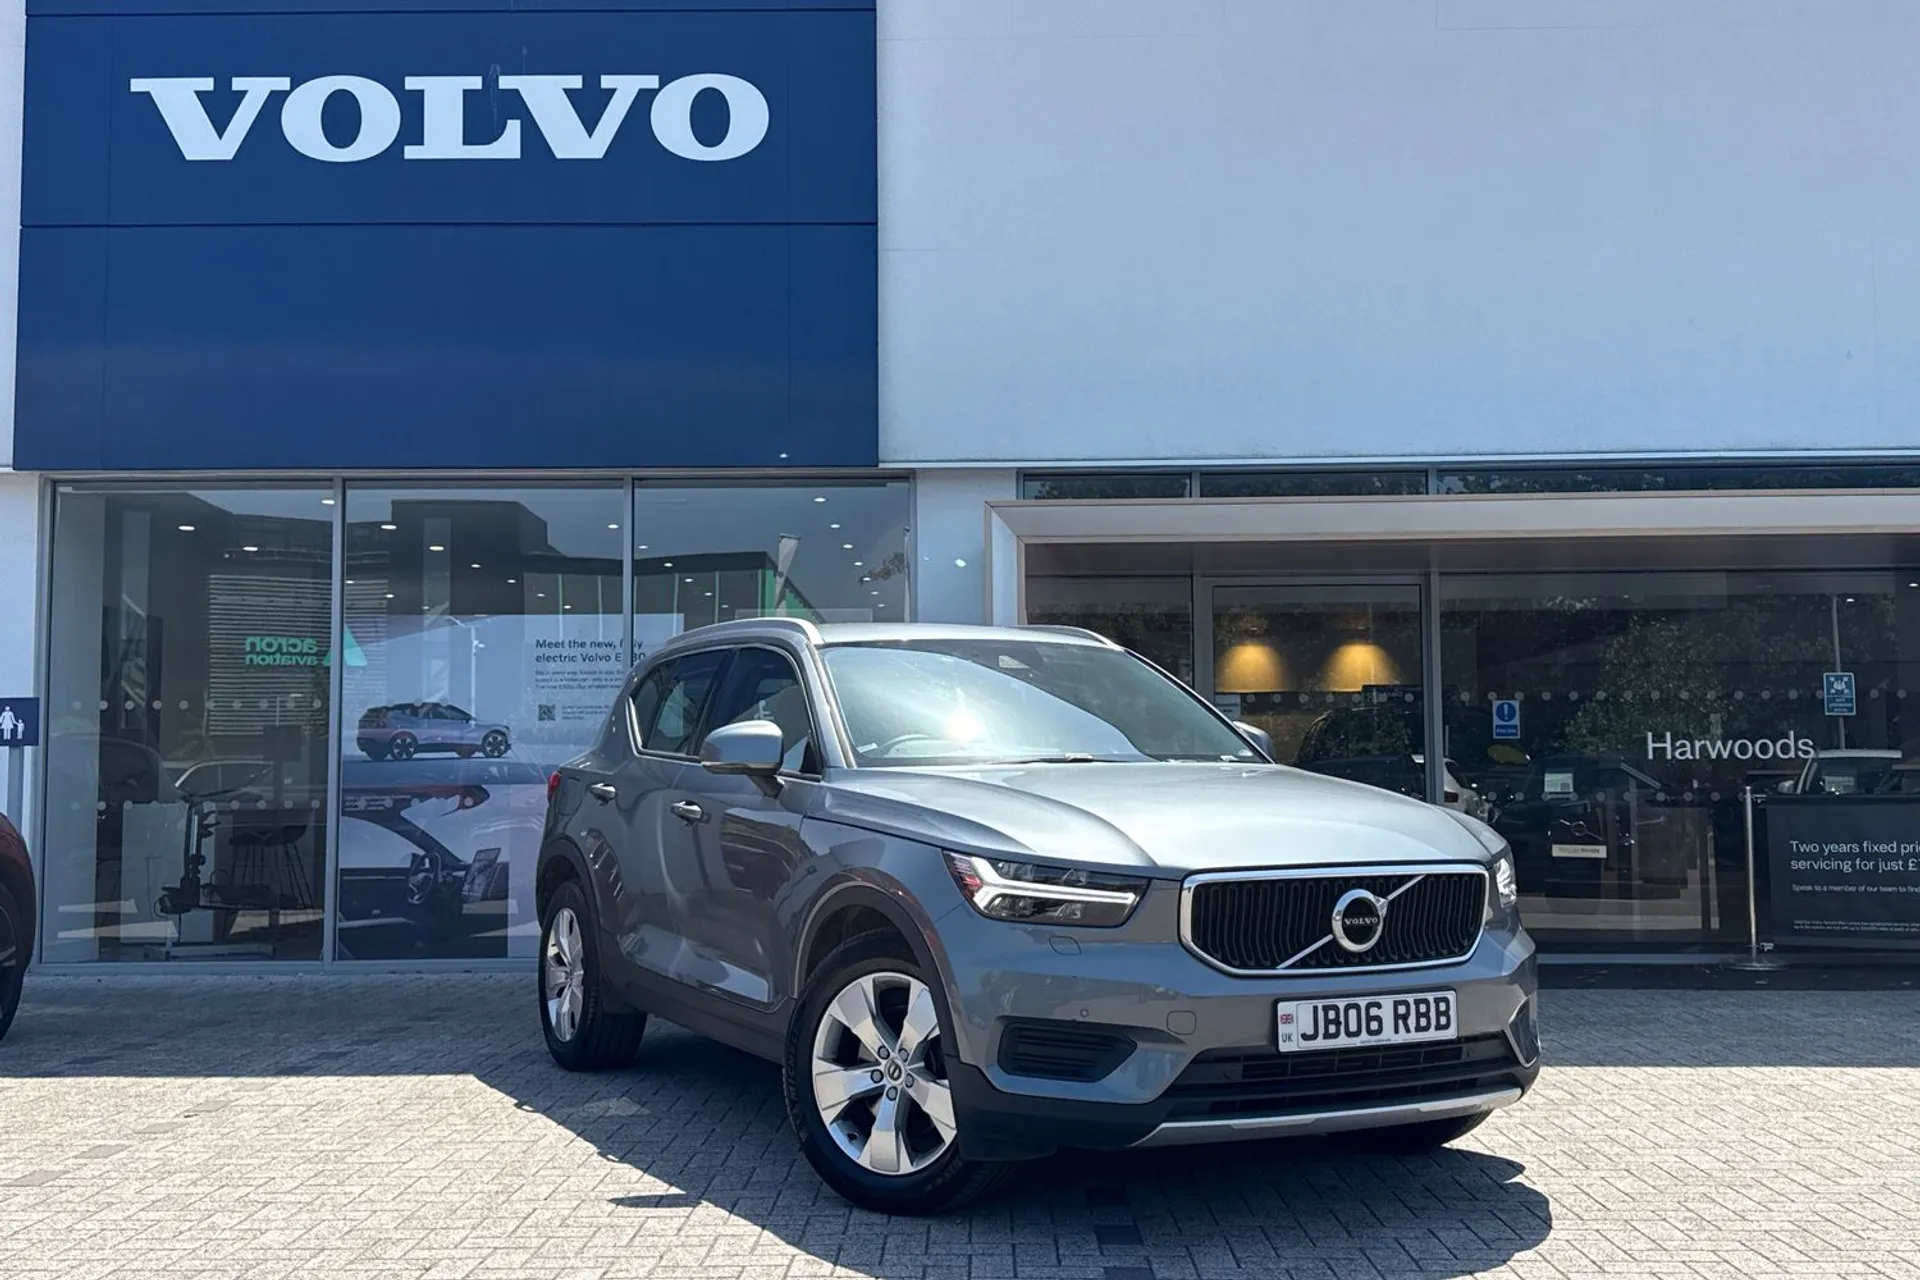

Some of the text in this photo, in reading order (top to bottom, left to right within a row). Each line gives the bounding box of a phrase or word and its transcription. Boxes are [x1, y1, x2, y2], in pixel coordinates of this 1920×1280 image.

[130, 73, 770, 162] VOLVO
[535, 639, 565, 649] Meet
[568, 639, 588, 649] the
[589, 641, 617, 650] new,
[535, 652, 646, 663] electric Volvo E30
[1647, 730, 1815, 760] Harwoods
[1790, 841, 1920, 856] Two years fixed pri
[1790, 858, 1852, 873] servicing
[1855, 858, 1875, 870] for
[1878, 858, 1904, 873] just
[1792, 883, 1813, 892] Speak
[1814, 884, 1822, 892] to
[1828, 884, 1857, 892] member
[1858, 884, 1866, 892] of
[1899, 885, 1907, 893] to
[1343, 917, 1379, 925] VOLVO
[1300, 996, 1451, 1042] JB06 RBB
[1281, 1032, 1293, 1043] UK
